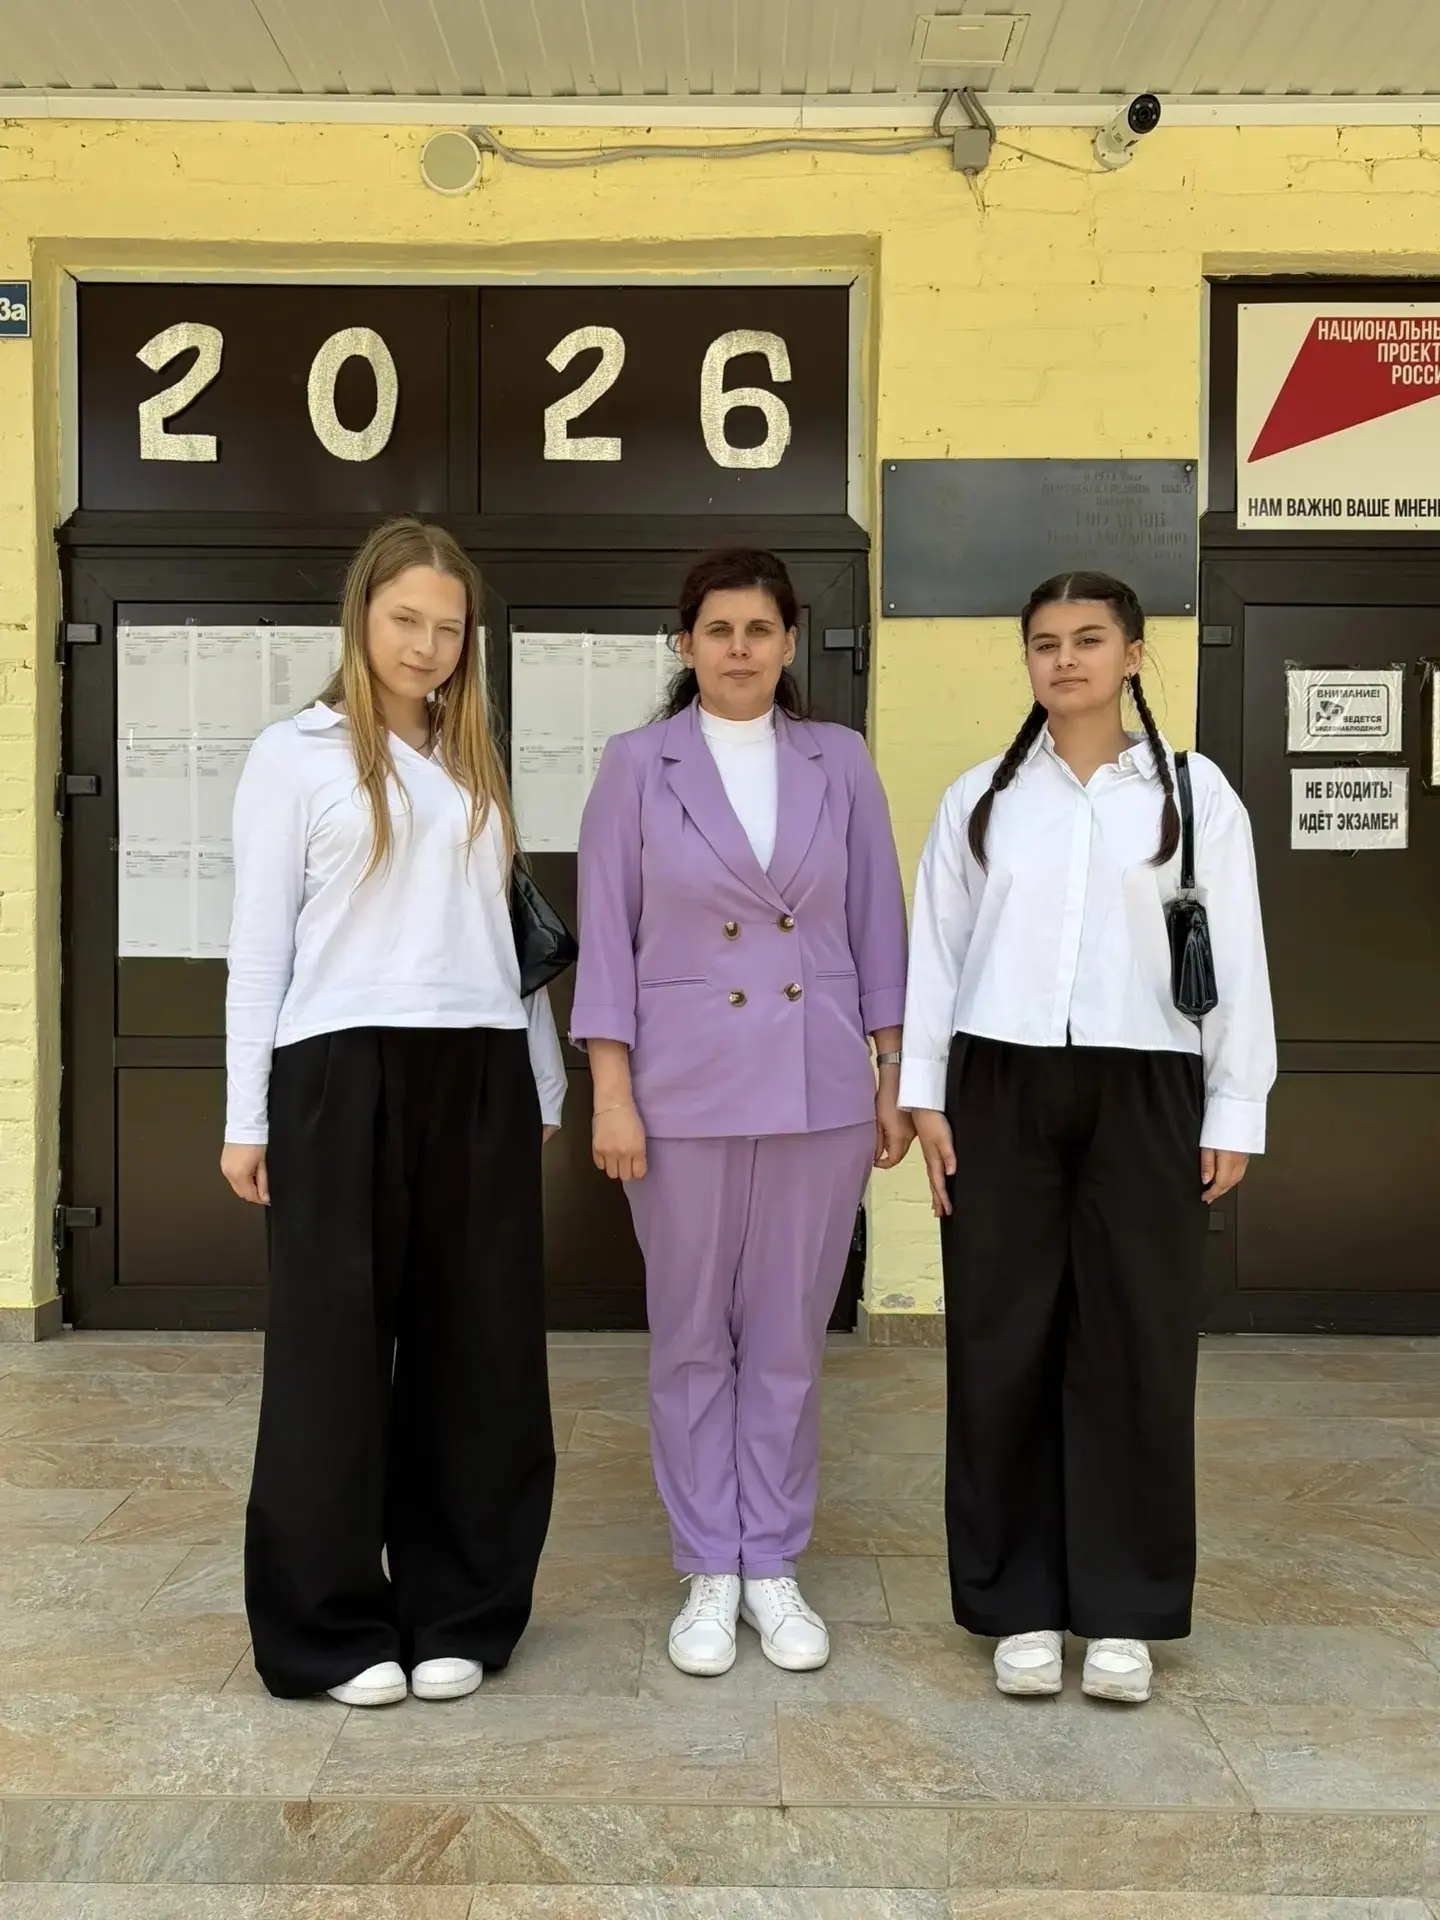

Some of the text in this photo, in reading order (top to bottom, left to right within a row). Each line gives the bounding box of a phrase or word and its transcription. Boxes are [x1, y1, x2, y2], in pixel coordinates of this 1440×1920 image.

[1248, 498, 1440, 517] НАМ ВАЖНО ВАШЕ МНЕН
[1316, 689, 1380, 698] ВНИМАНИЕ!
[1342, 715, 1382, 723] ВЕДЕТСЯ
[1305, 781, 1392, 801] НЕ ВХОДИТЬ!
[1299, 810, 1399, 833] ИДЁТ ЭКЗАМЕН
